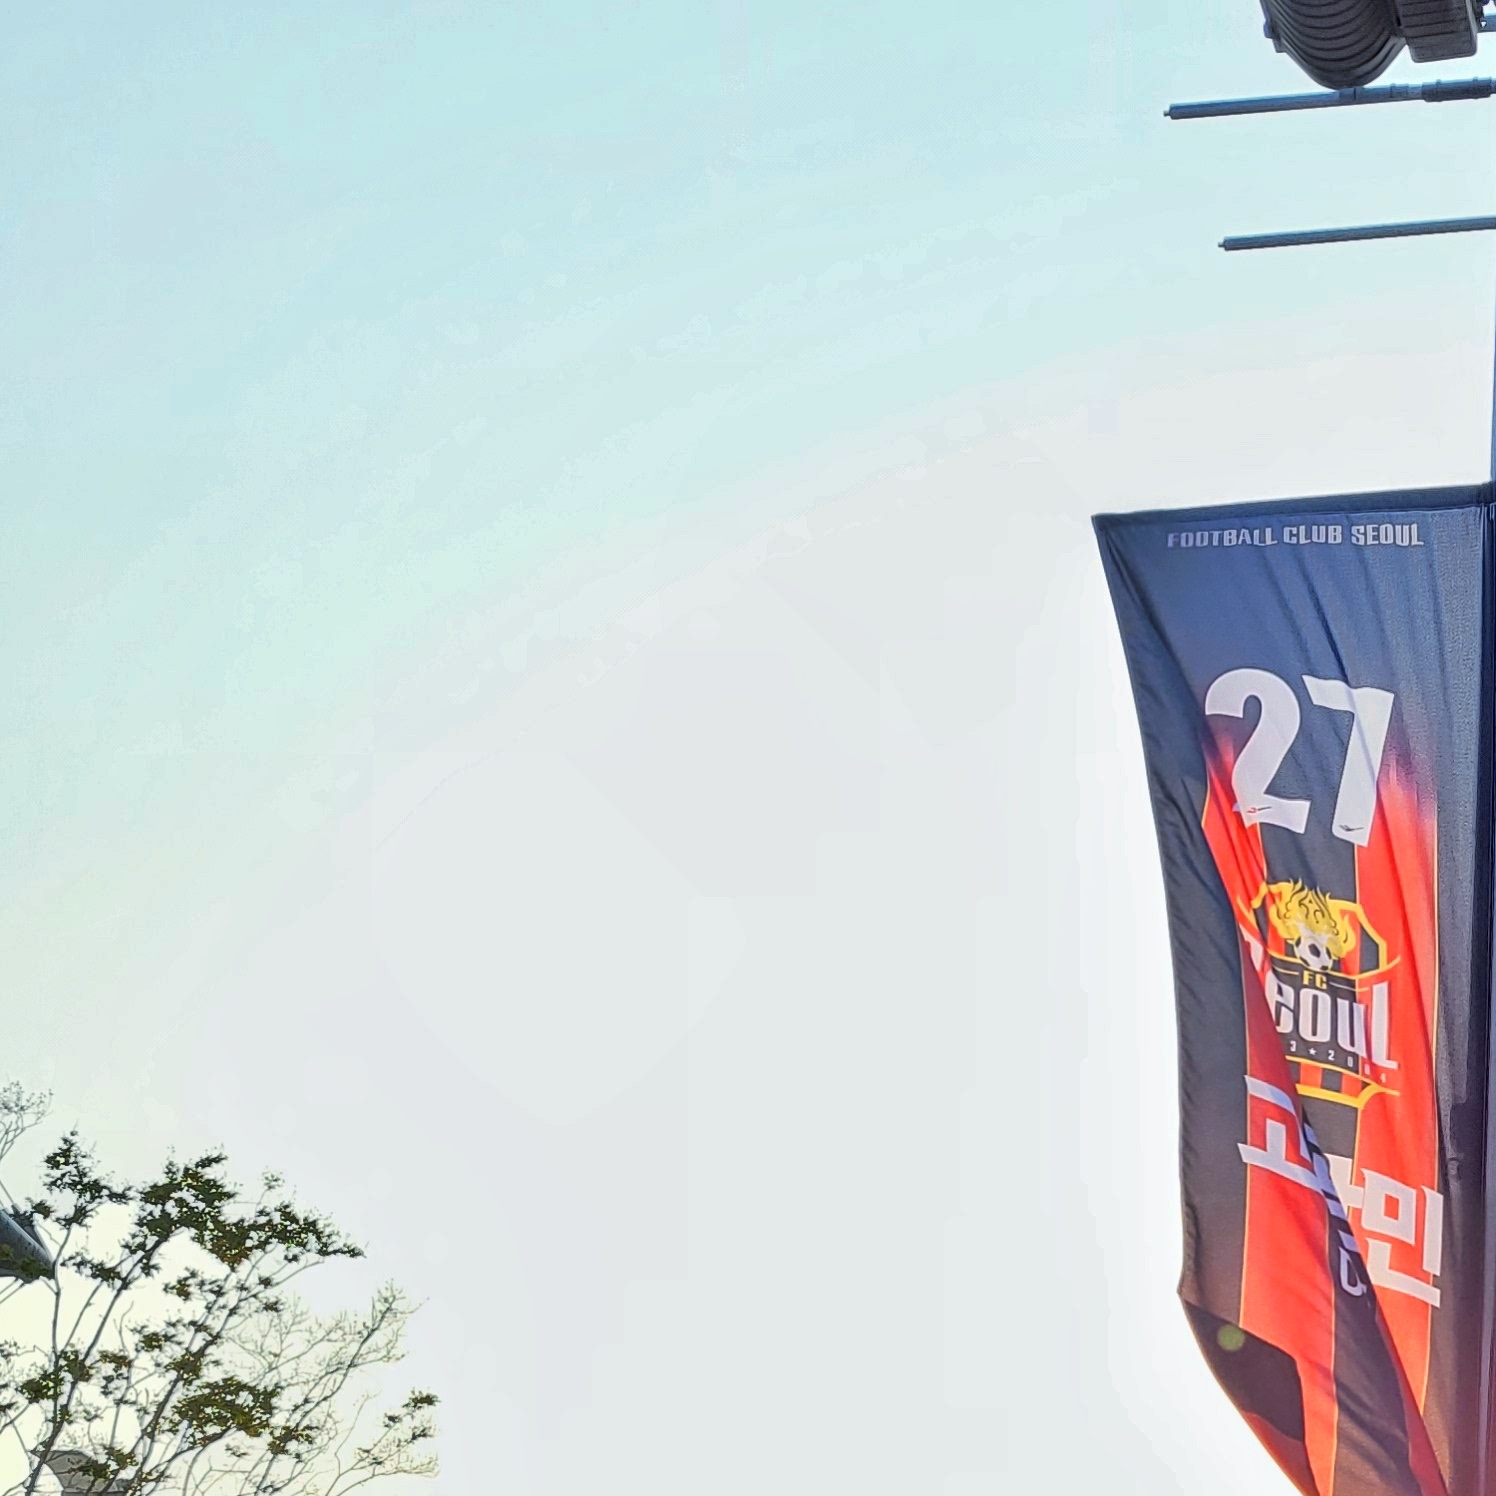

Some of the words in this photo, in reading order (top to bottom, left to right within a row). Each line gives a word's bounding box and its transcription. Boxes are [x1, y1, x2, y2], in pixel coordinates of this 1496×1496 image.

[1167, 527, 1278, 547] FOOTBALL
[1283, 524, 1342, 545] CLUB
[1351, 523, 1424, 546] SEOUL
[1204, 668, 1394, 847] 27
[1303, 970, 1327, 990] FC
